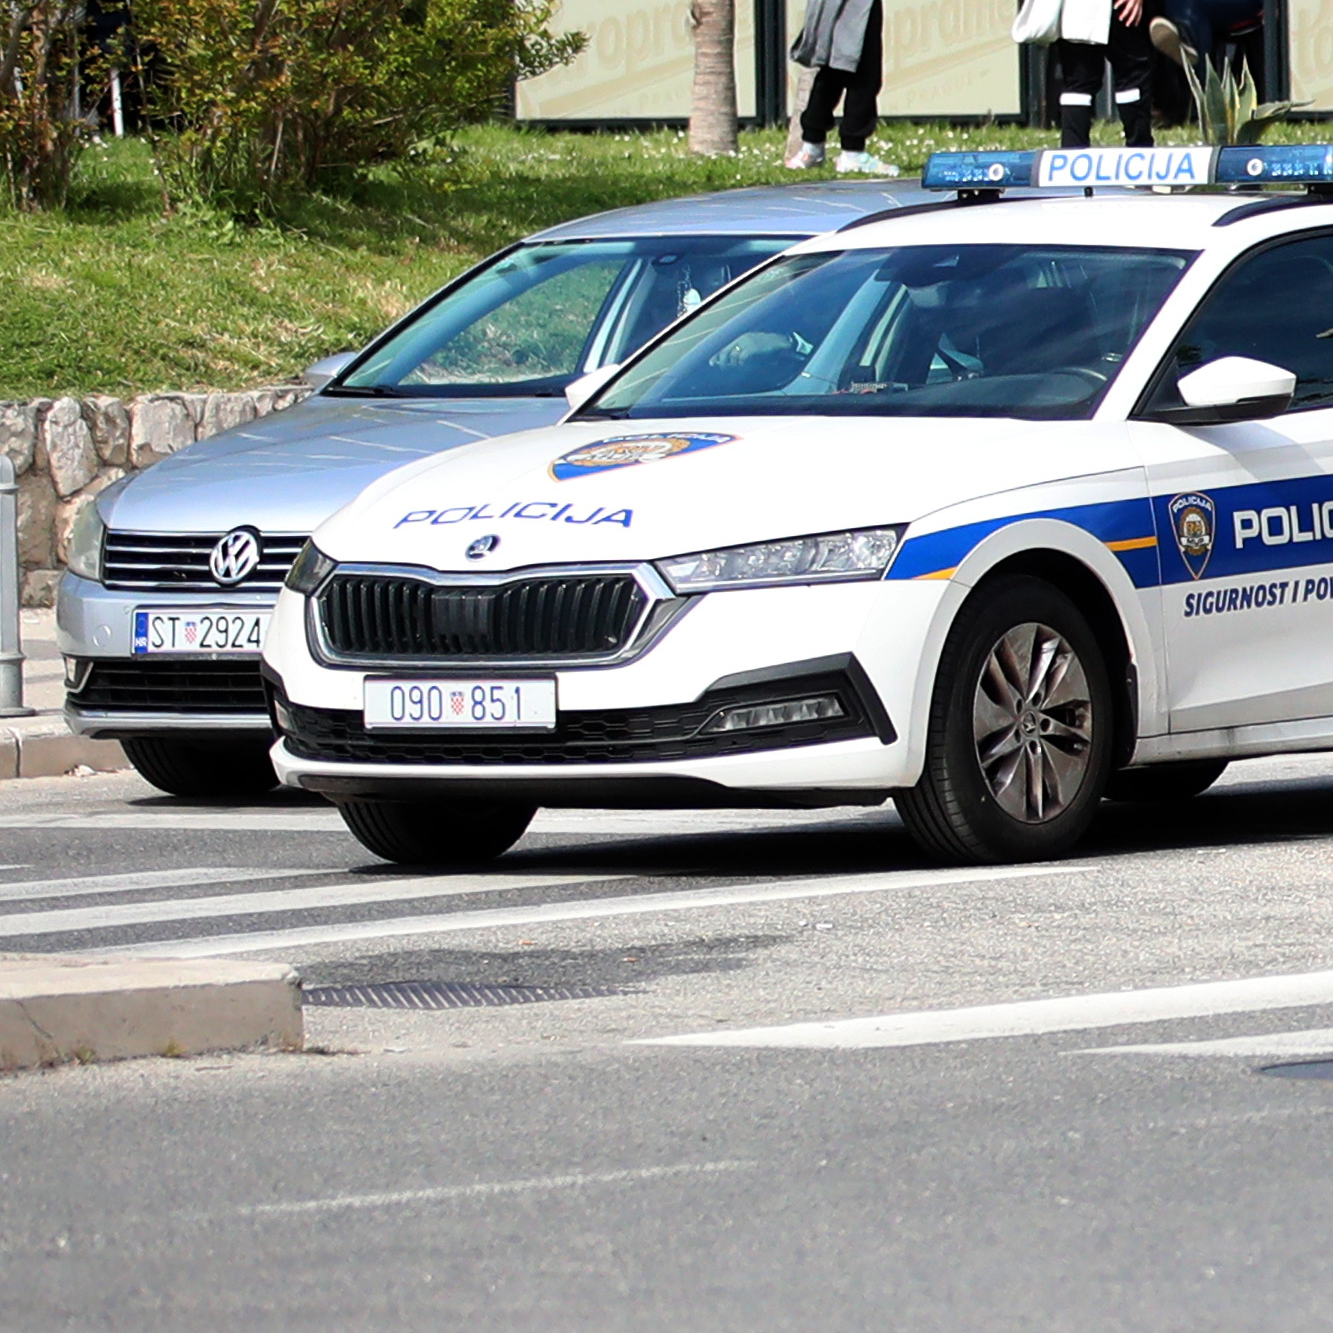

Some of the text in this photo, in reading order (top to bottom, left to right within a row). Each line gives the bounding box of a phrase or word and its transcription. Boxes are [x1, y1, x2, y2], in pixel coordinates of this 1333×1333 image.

[1047, 151, 1196, 183] POLICIJA
[393, 501, 634, 529] POLICIJA
[1172, 495, 1213, 513] POLICIJA
[1183, 580, 1290, 618] SIGURNOST
[1291, 580, 1300, 604] I
[151, 614, 262, 649] ST 2924
[389, 684, 523, 722] 090 851
